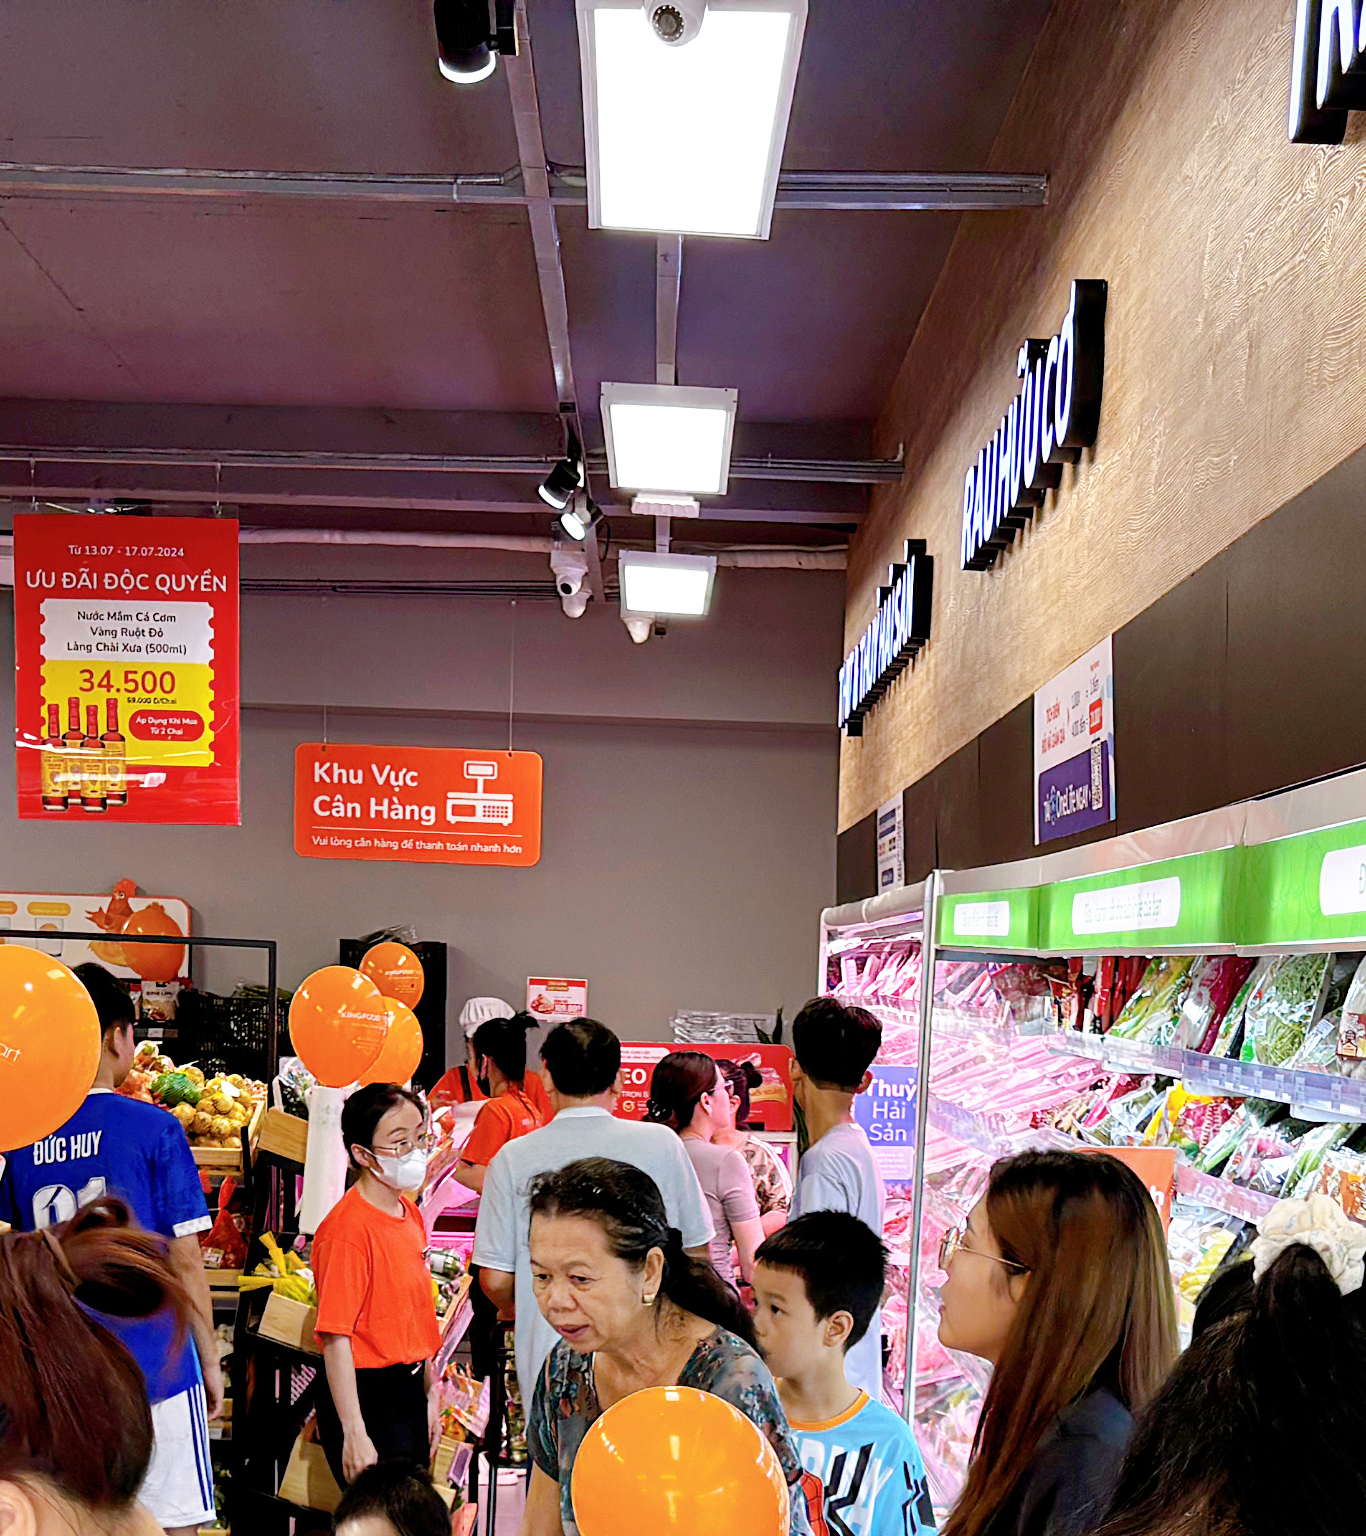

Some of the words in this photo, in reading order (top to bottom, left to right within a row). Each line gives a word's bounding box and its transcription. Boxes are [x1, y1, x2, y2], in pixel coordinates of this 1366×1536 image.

[961, 427, 999, 570] RAU
[68, 545, 82, 556] Từ
[84, 546, 114, 557] 13.07
[125, 546, 185, 558] 17.07.2024
[26, 570, 57, 589] ƯU
[60, 569, 98, 590] ĐÃI
[103, 571, 150, 595] ĐỘC
[155, 569, 227, 593] QUYỀN
[78, 611, 104, 623] Nước
[107, 611, 132, 623] Mắm
[135, 612, 150, 623] Cá
[153, 612, 176, 624] Cơm
[79, 668, 176, 693] 34.500
[314, 761, 363, 787] Khu
[371, 763, 419, 790] Vực
[313, 794, 363, 820] Cân
[370, 795, 436, 826] Hàng
[311, 836, 327, 847] Vui
[330, 836, 352, 851] lòng
[355, 837, 374, 850] cân
[376, 838, 399, 853] hàng
[401, 838, 413, 851] để
[415, 839, 443, 852] thanh
[446, 840, 468, 853] toán
[471, 842, 500, 855] nhanh
[503, 843, 522, 855] hơn
[872, 1100, 906, 1120] Hải
[869, 1122, 907, 1142] Sản
[33, 1133, 66, 1165] ĐỨC
[69, 1130, 103, 1160] HUY
